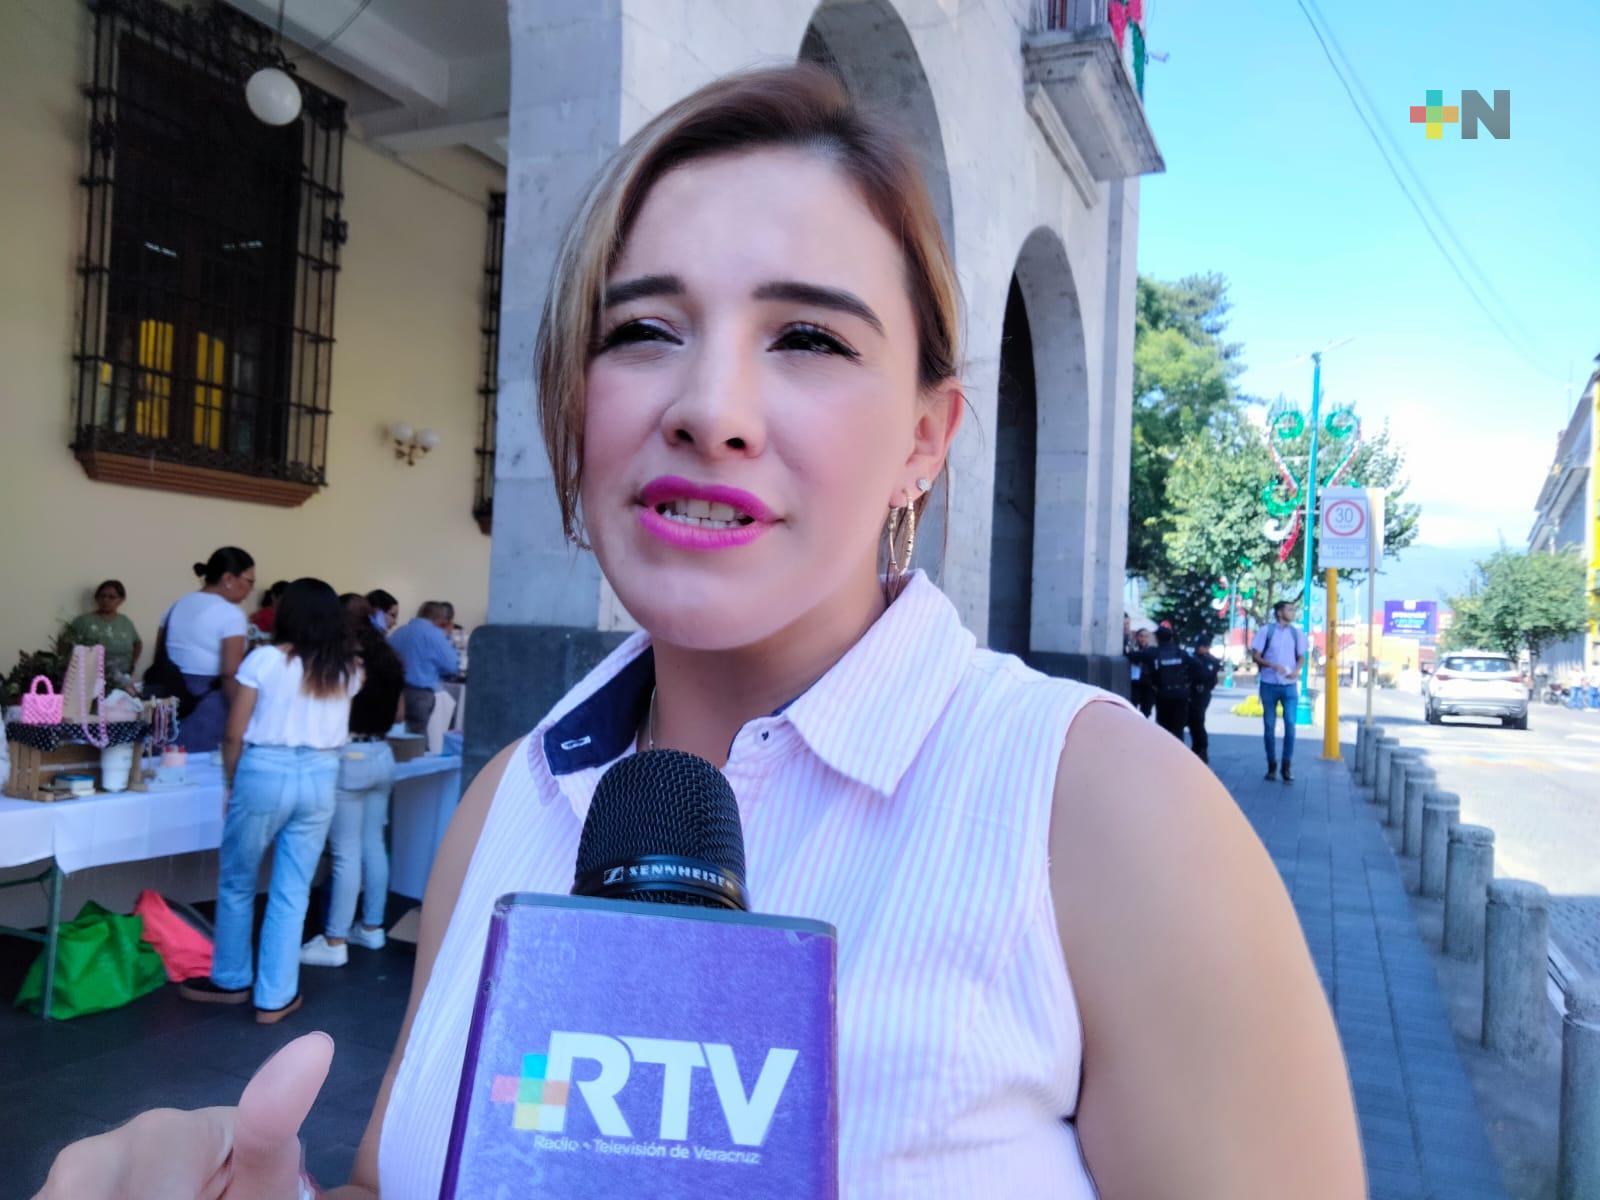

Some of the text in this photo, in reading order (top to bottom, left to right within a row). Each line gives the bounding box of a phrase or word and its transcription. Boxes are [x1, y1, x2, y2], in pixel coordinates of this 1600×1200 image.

[1335, 507, 1353, 523] 30
[536, 1030, 799, 1146] RTV
[534, 1134, 761, 1164] Radio Televisión de Veracruz
